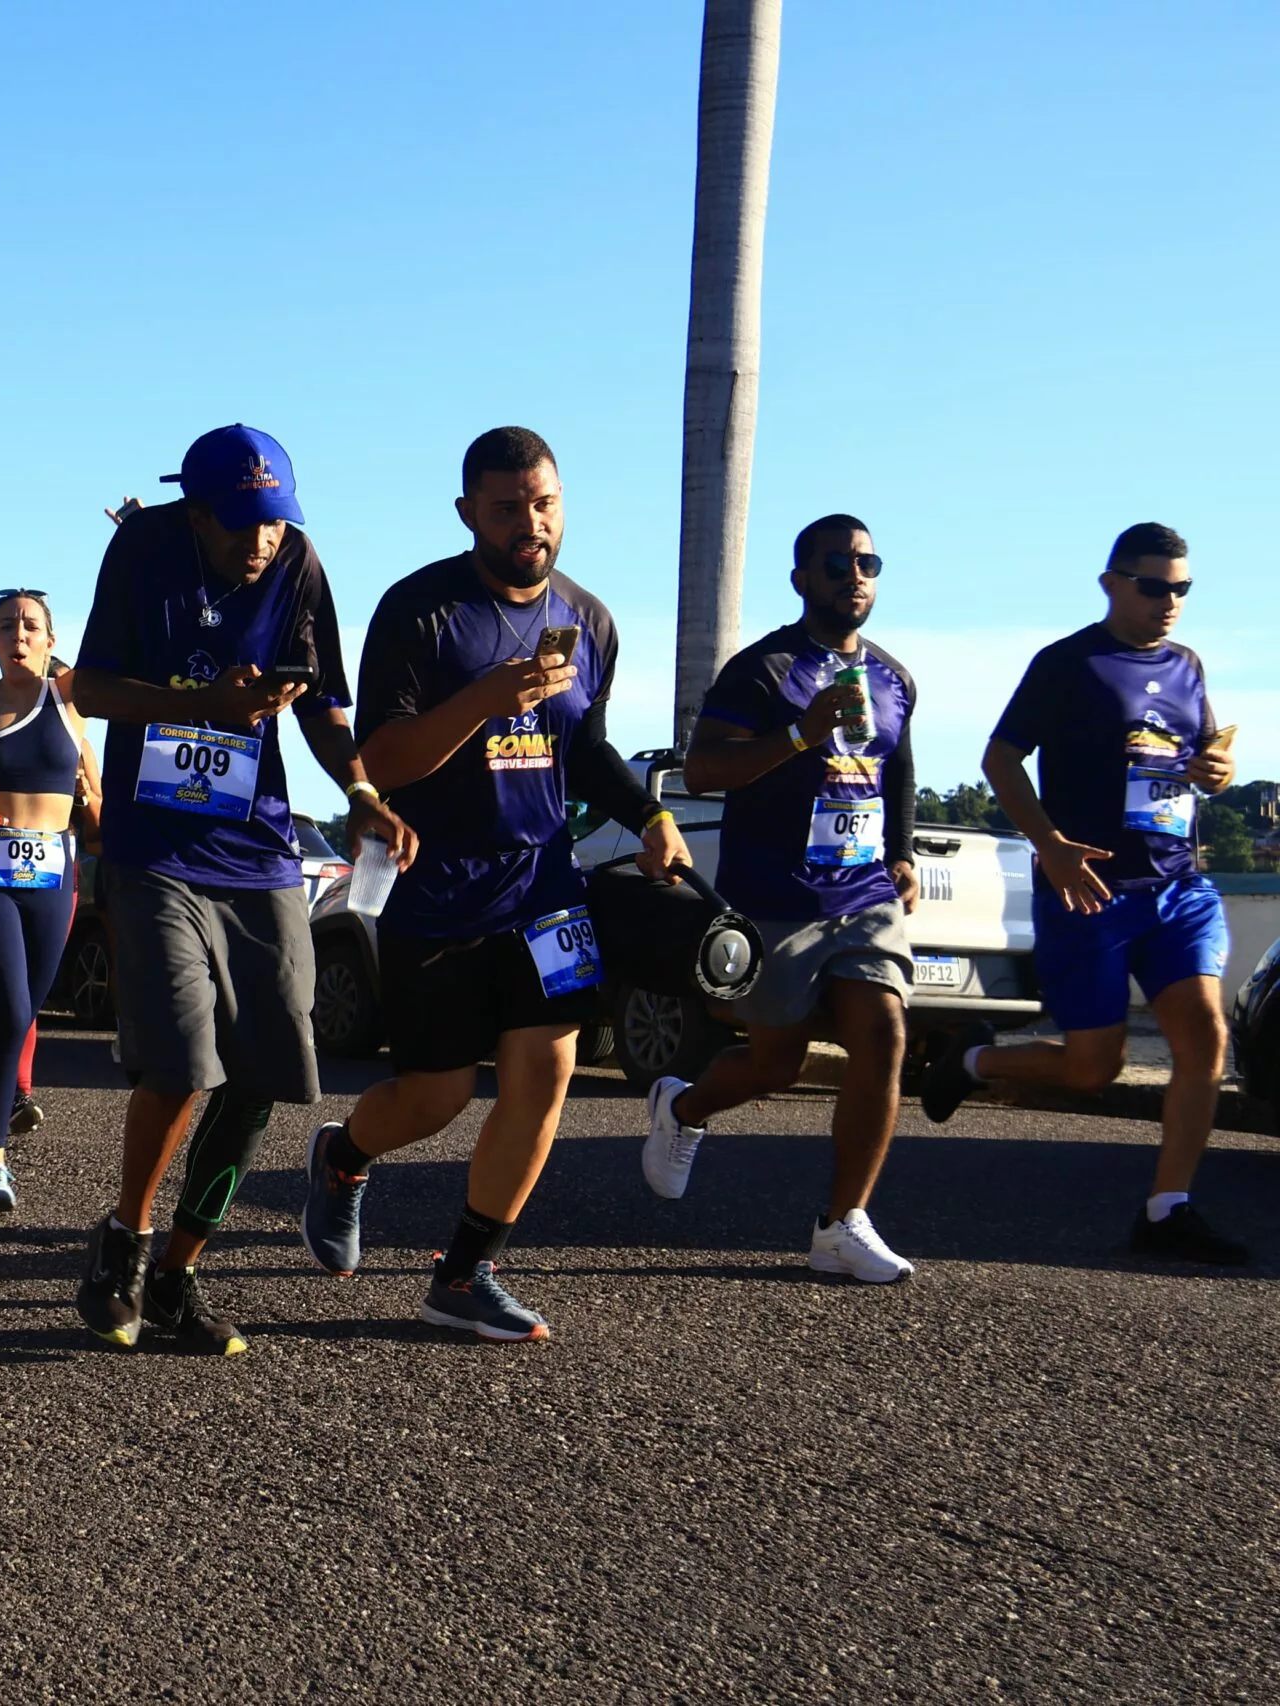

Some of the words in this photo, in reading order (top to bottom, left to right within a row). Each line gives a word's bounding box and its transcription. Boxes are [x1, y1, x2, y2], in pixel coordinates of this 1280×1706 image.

[159, 727, 198, 740] CORRIDA
[201, 734, 216, 743] DOS
[217, 736, 247, 750] BARES
[174, 742, 231, 777] 009
[176, 789, 209, 802] SONIC
[834, 813, 870, 835] 067
[7, 840, 45, 861] 093
[555, 921, 595, 953] 099
